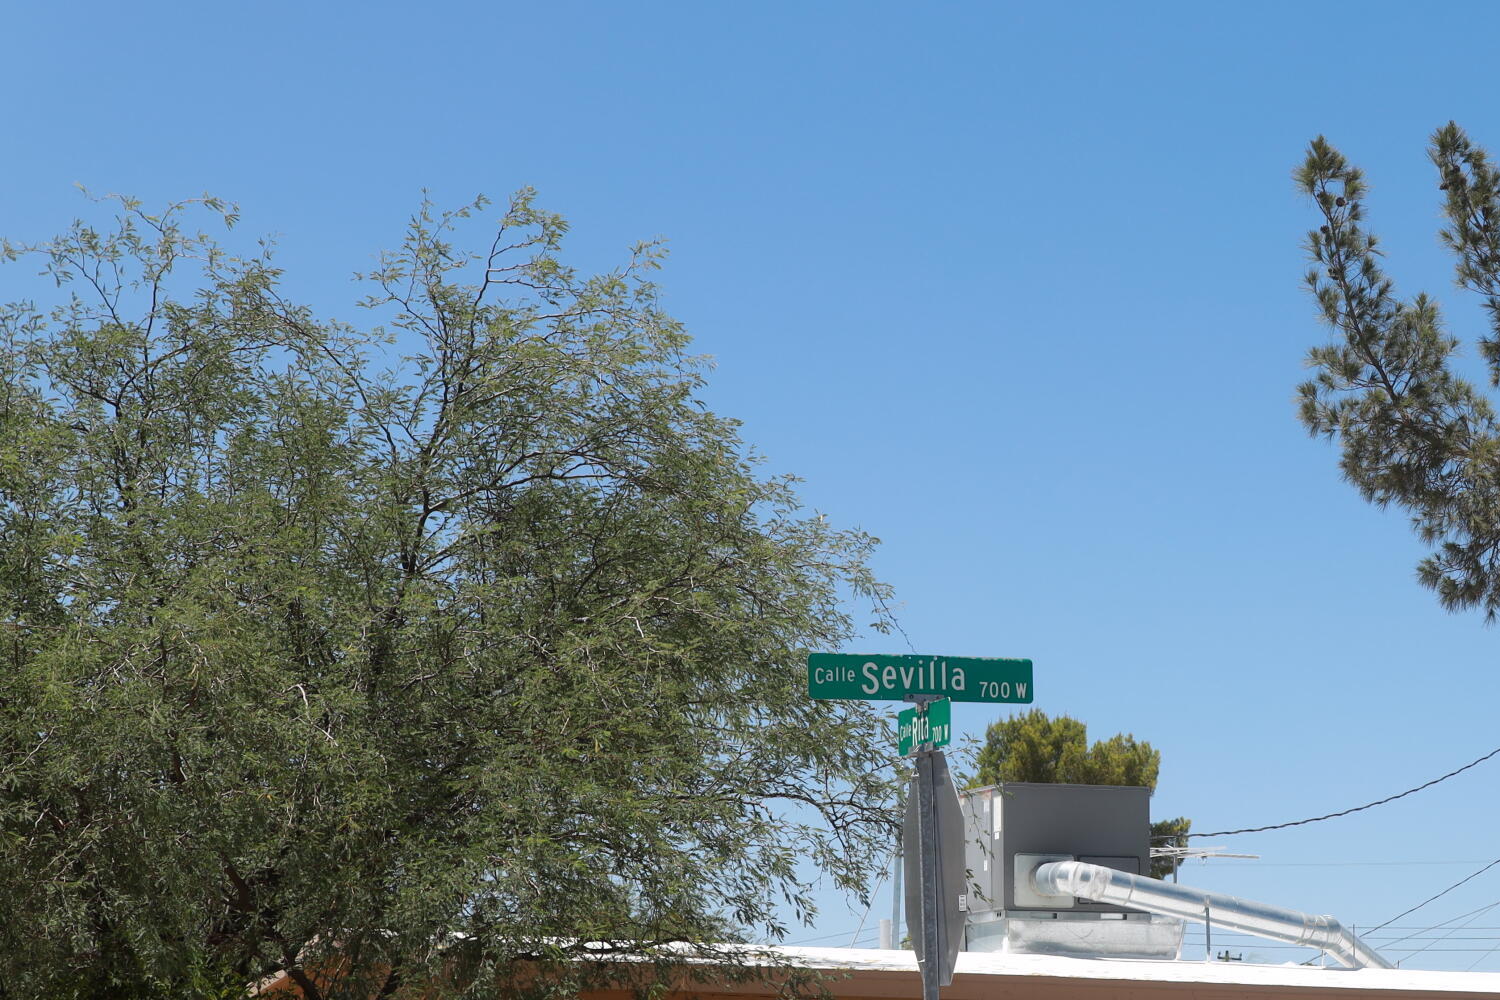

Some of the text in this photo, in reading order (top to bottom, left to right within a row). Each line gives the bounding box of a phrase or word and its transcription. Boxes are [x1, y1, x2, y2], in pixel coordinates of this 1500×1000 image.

[815, 661, 1027, 698] Calle Sevilla 700 W
[900, 716, 949, 746] Calle Rita 700 W
